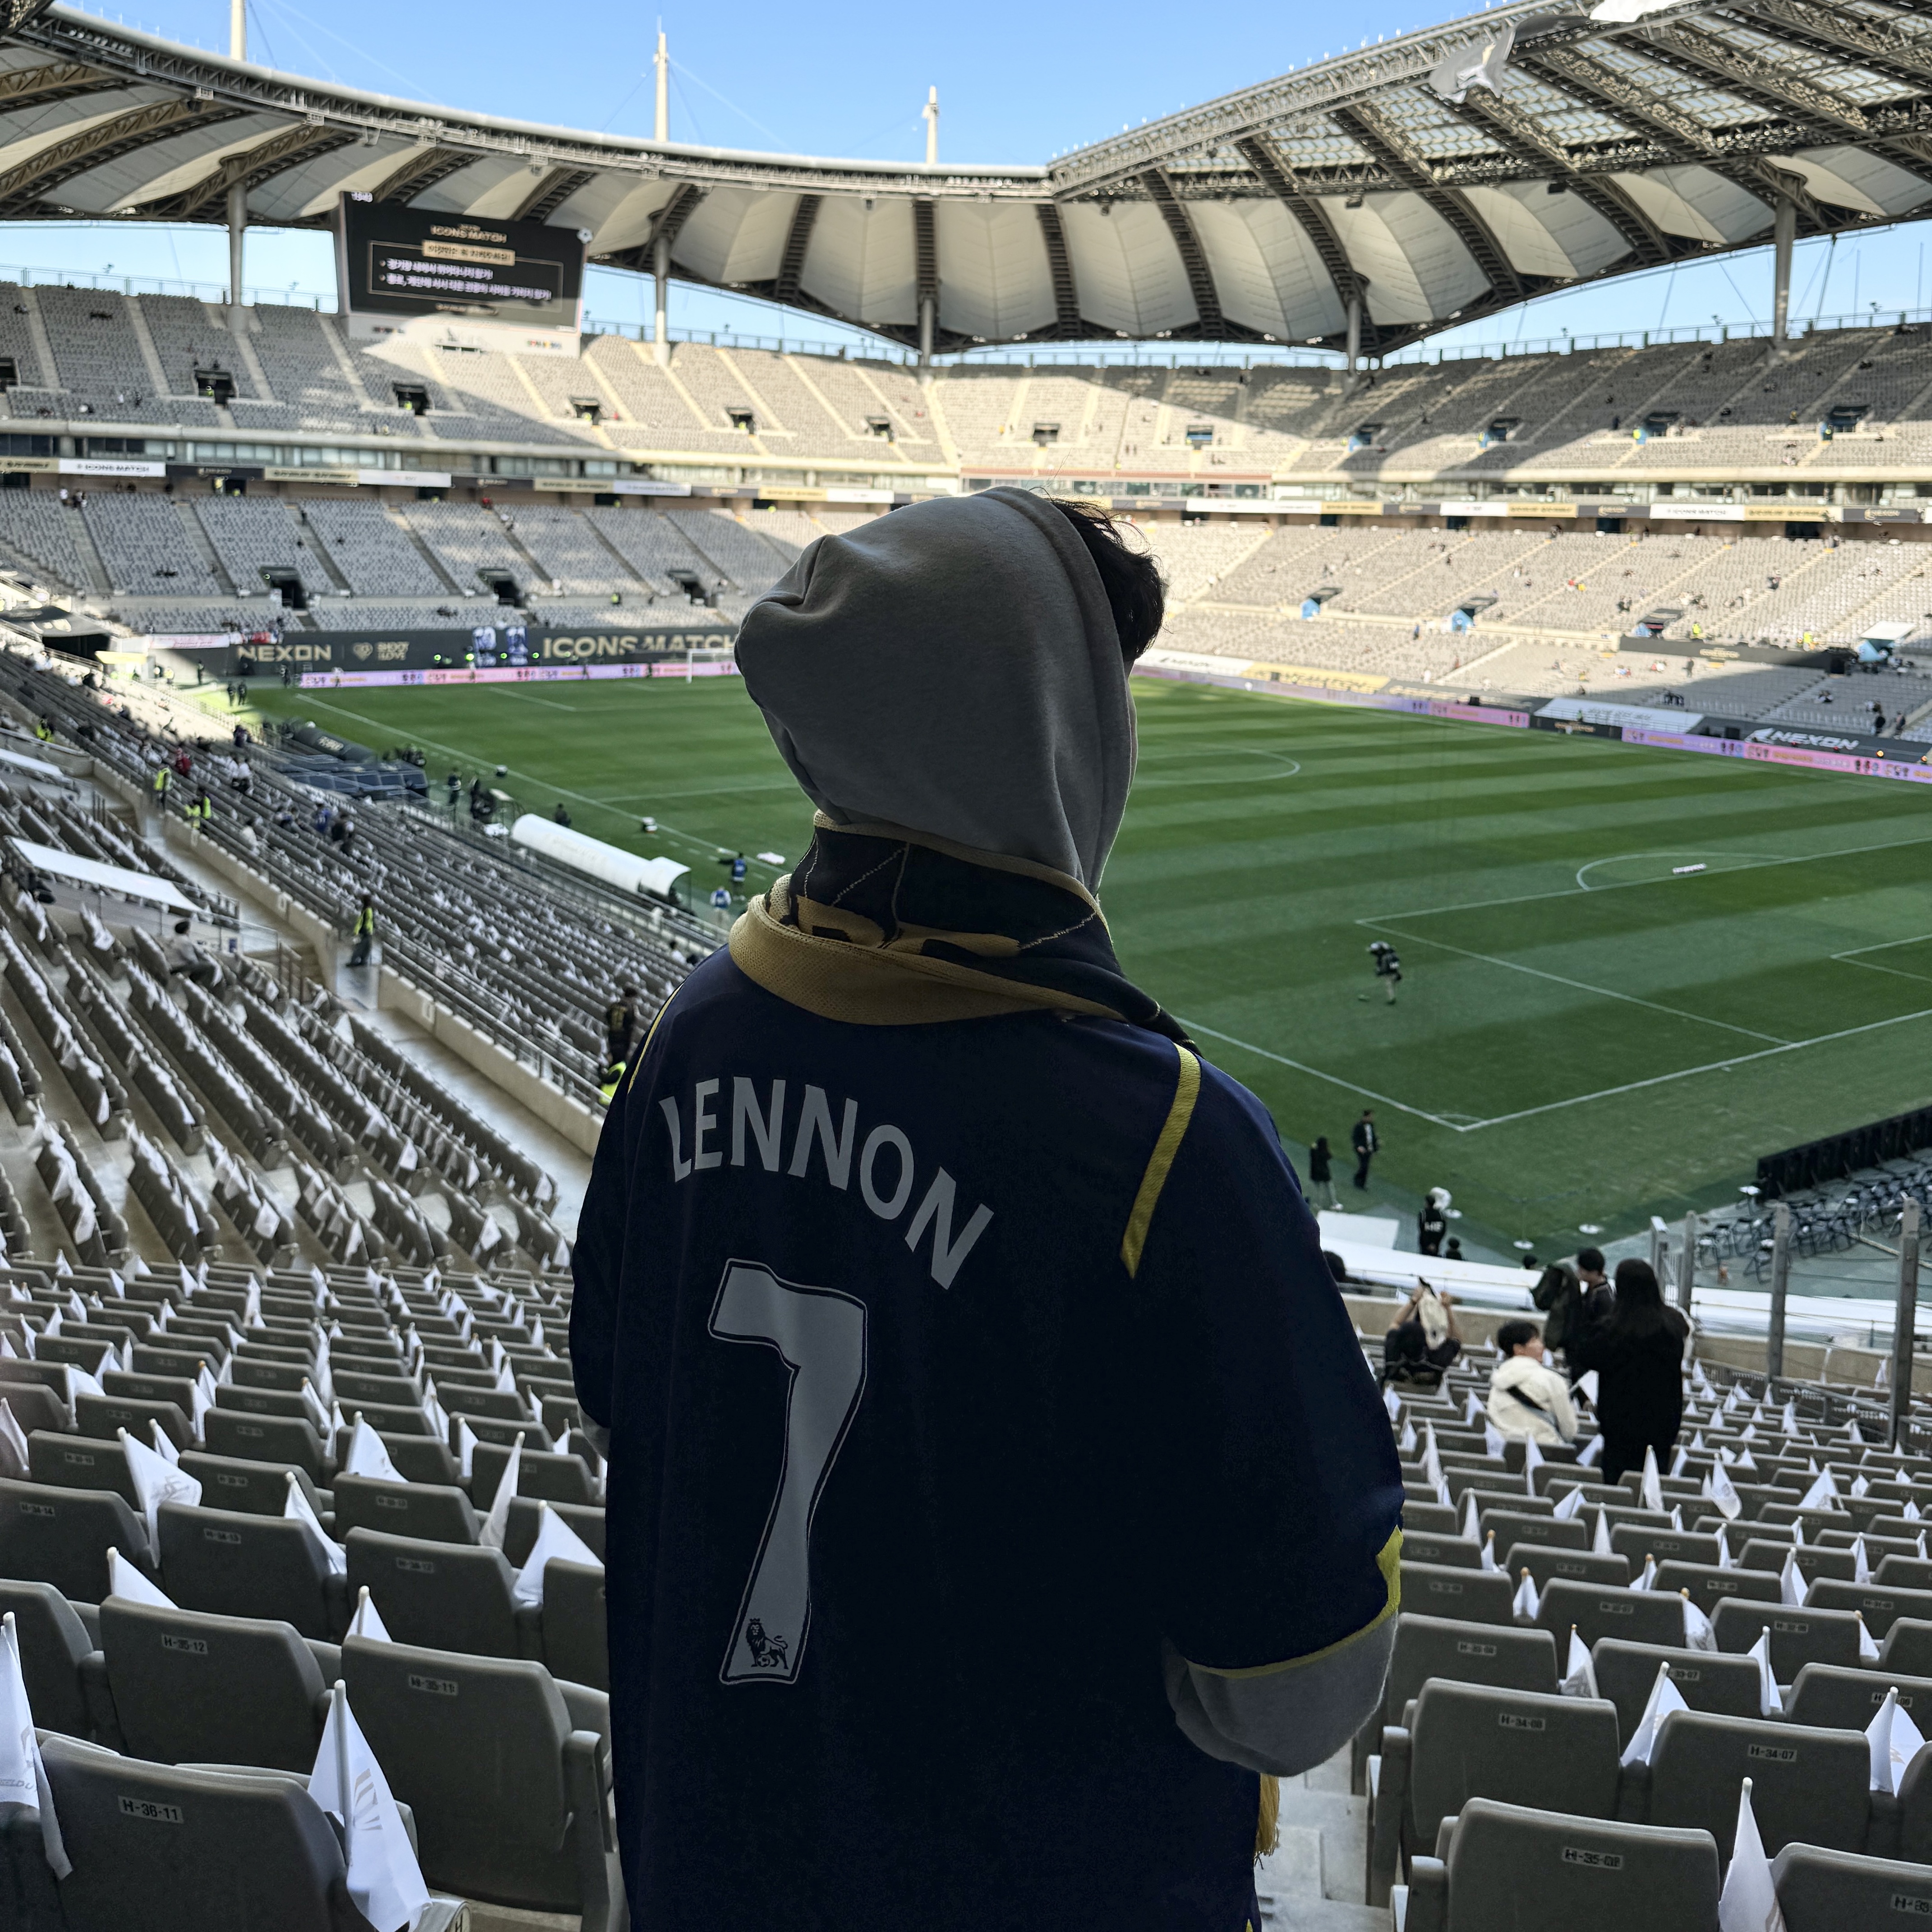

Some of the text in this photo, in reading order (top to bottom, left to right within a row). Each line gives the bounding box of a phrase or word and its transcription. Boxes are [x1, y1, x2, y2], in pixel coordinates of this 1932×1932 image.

[237, 644, 332, 662] NEXON
[543, 635, 639, 658] ICONS
[1770, 730, 1859, 750] NEXON
[658, 1076, 994, 1290] LENNON
[707, 1257, 867, 1685] 7
[1750, 1744, 1794, 1760] H-34-07
[123, 1799, 179, 1821] H-36-11
